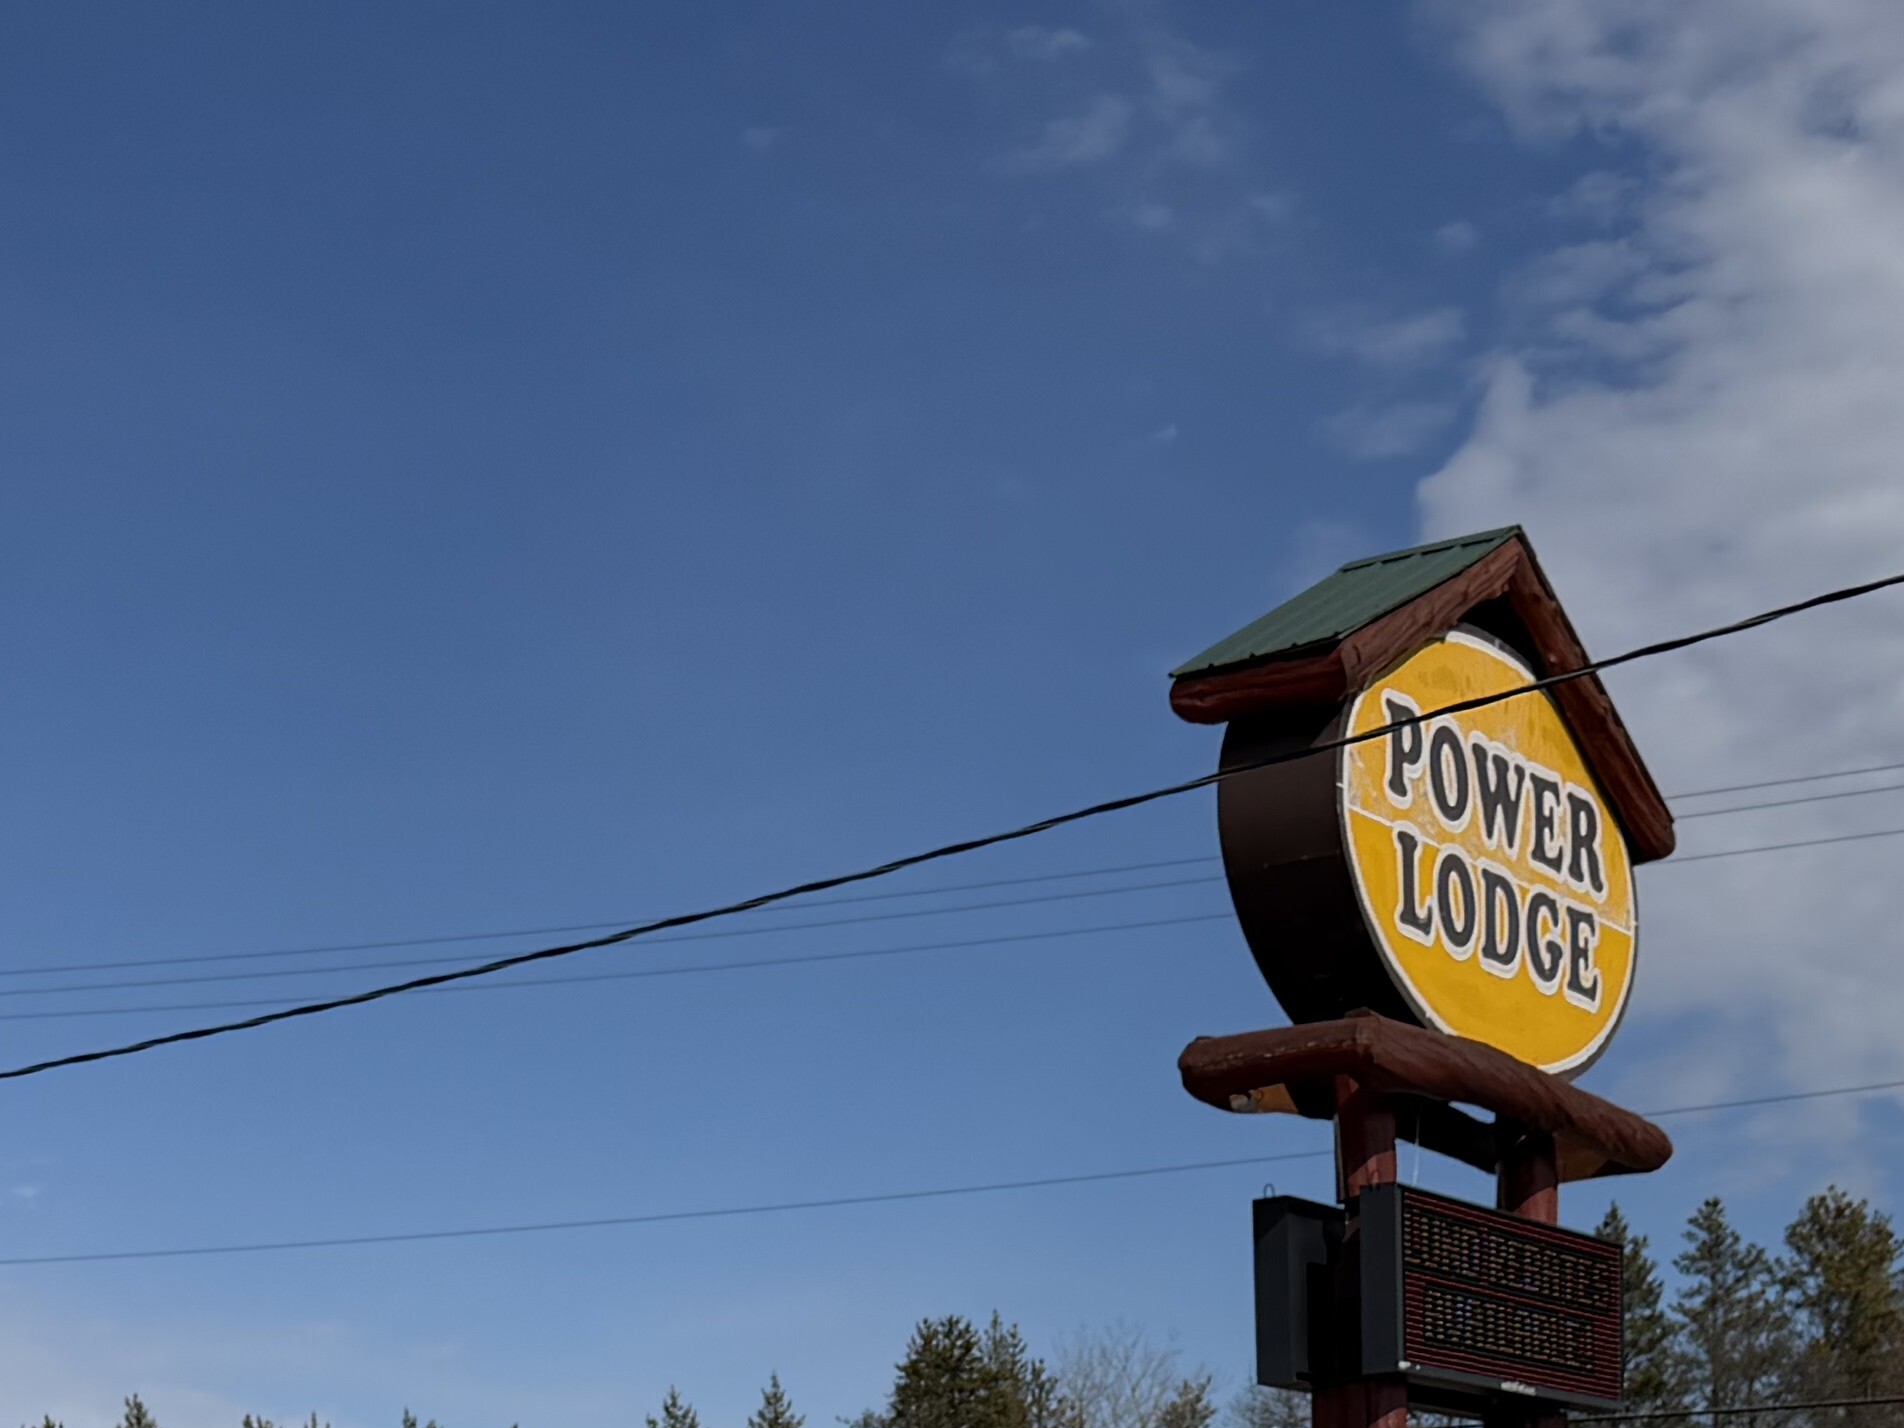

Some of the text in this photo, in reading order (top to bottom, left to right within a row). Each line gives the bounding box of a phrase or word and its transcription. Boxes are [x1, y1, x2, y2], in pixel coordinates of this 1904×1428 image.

[1384, 693, 1606, 897] POWER
[1395, 826, 1600, 1006] LODGE
[1403, 1212, 1610, 1309] LUND REBATES
[1424, 1290, 1594, 1370] AVAILABLE!
